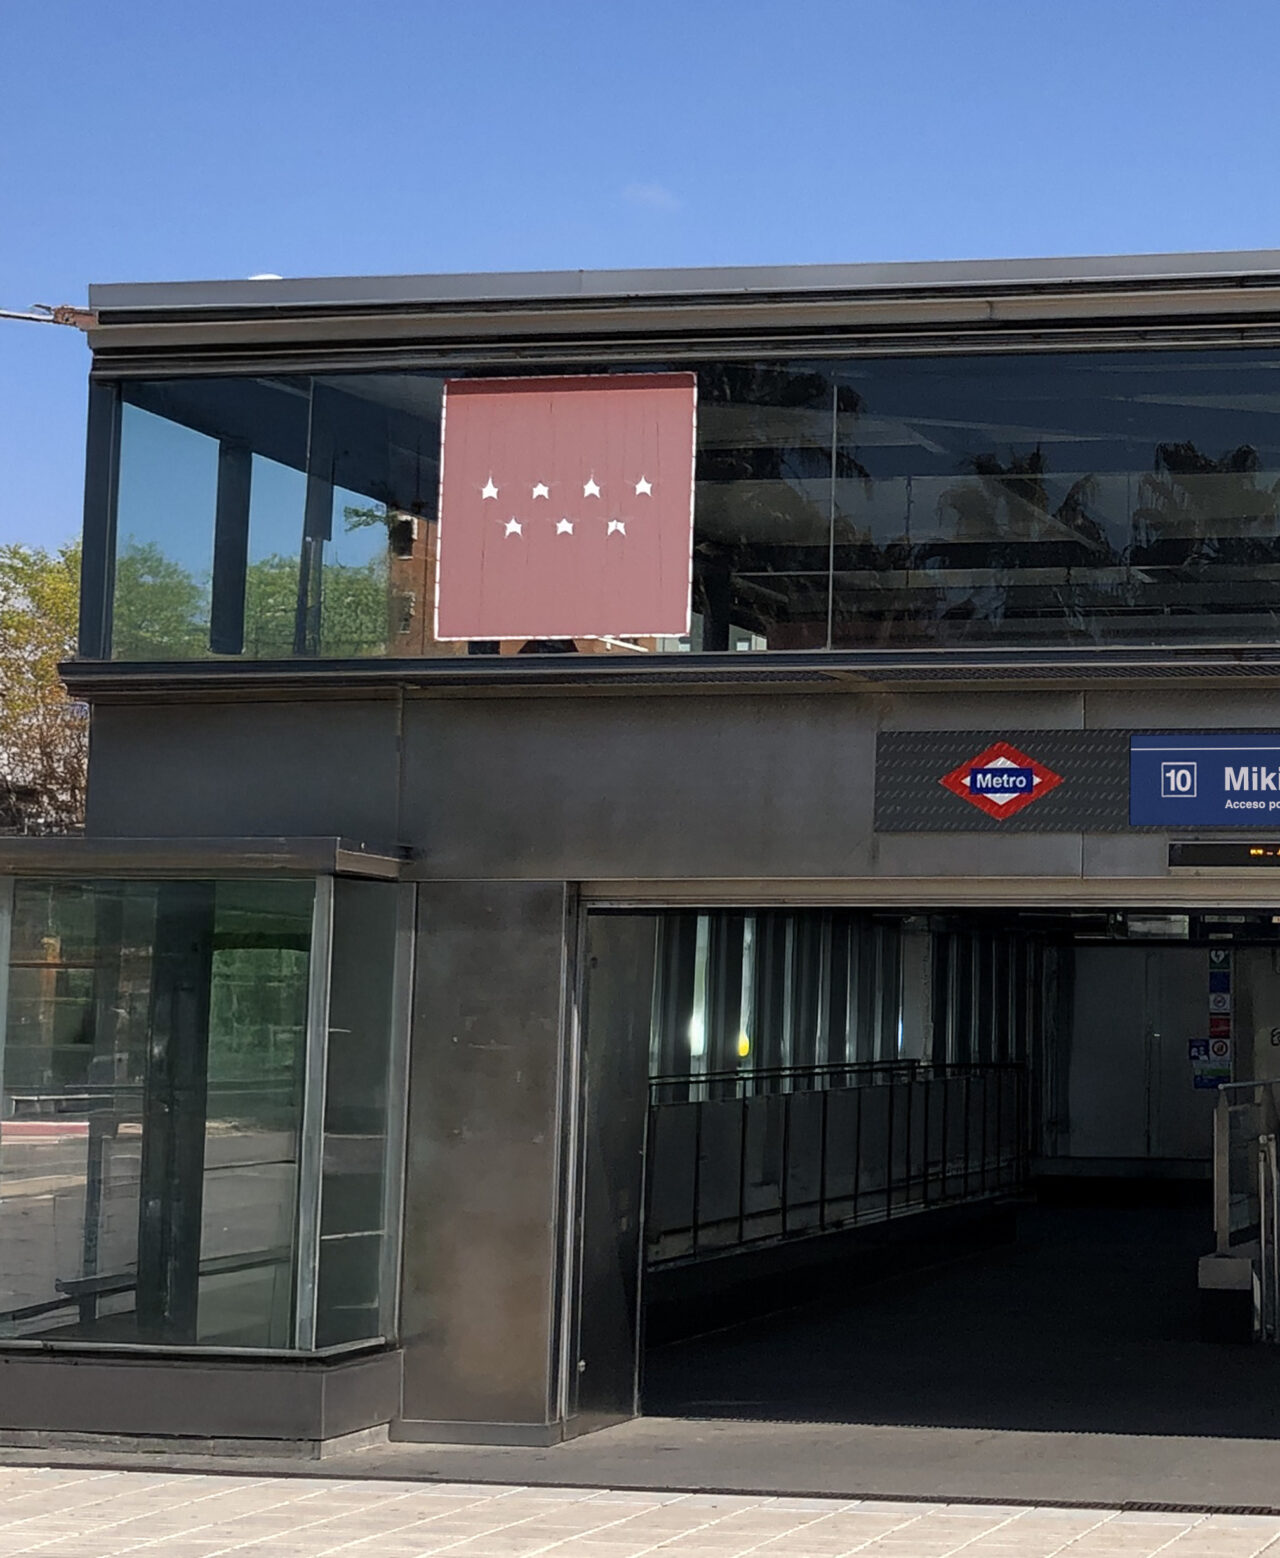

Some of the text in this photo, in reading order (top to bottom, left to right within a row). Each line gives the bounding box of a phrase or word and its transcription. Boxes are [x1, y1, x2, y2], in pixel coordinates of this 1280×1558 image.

[976, 773, 1027, 789] Metro
[1165, 769, 1192, 792] 10
[1225, 798, 1266, 809] Acceso
